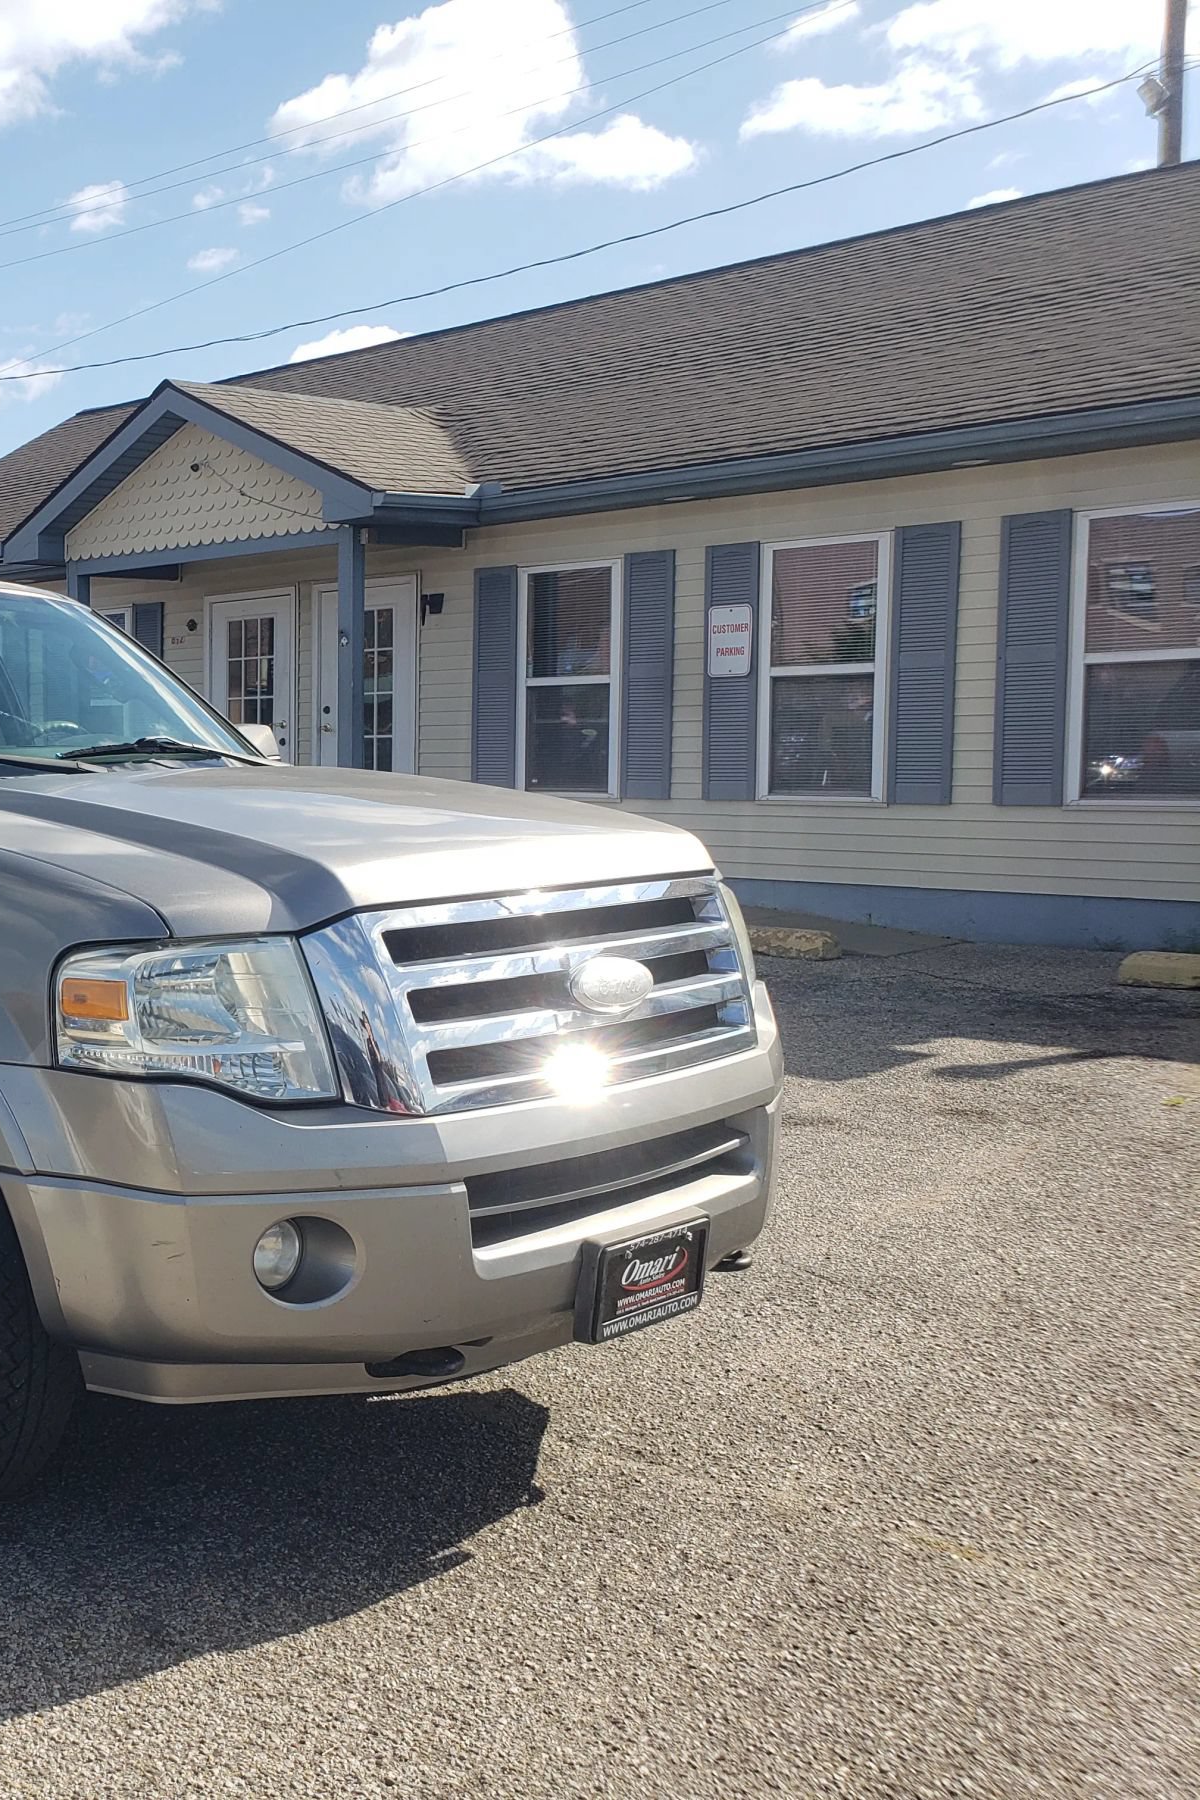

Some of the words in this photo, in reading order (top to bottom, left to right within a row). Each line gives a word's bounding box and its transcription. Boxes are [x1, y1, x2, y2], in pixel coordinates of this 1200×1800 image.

[712, 623, 749, 635] CUSTOMER
[716, 646, 745, 657] PARKING
[621, 1245, 681, 1285] Omari
[617, 1278, 686, 1307] WWW.OMARIAUTO.COM
[603, 1295, 698, 1337] WWW.OMARIAUTO.COM
